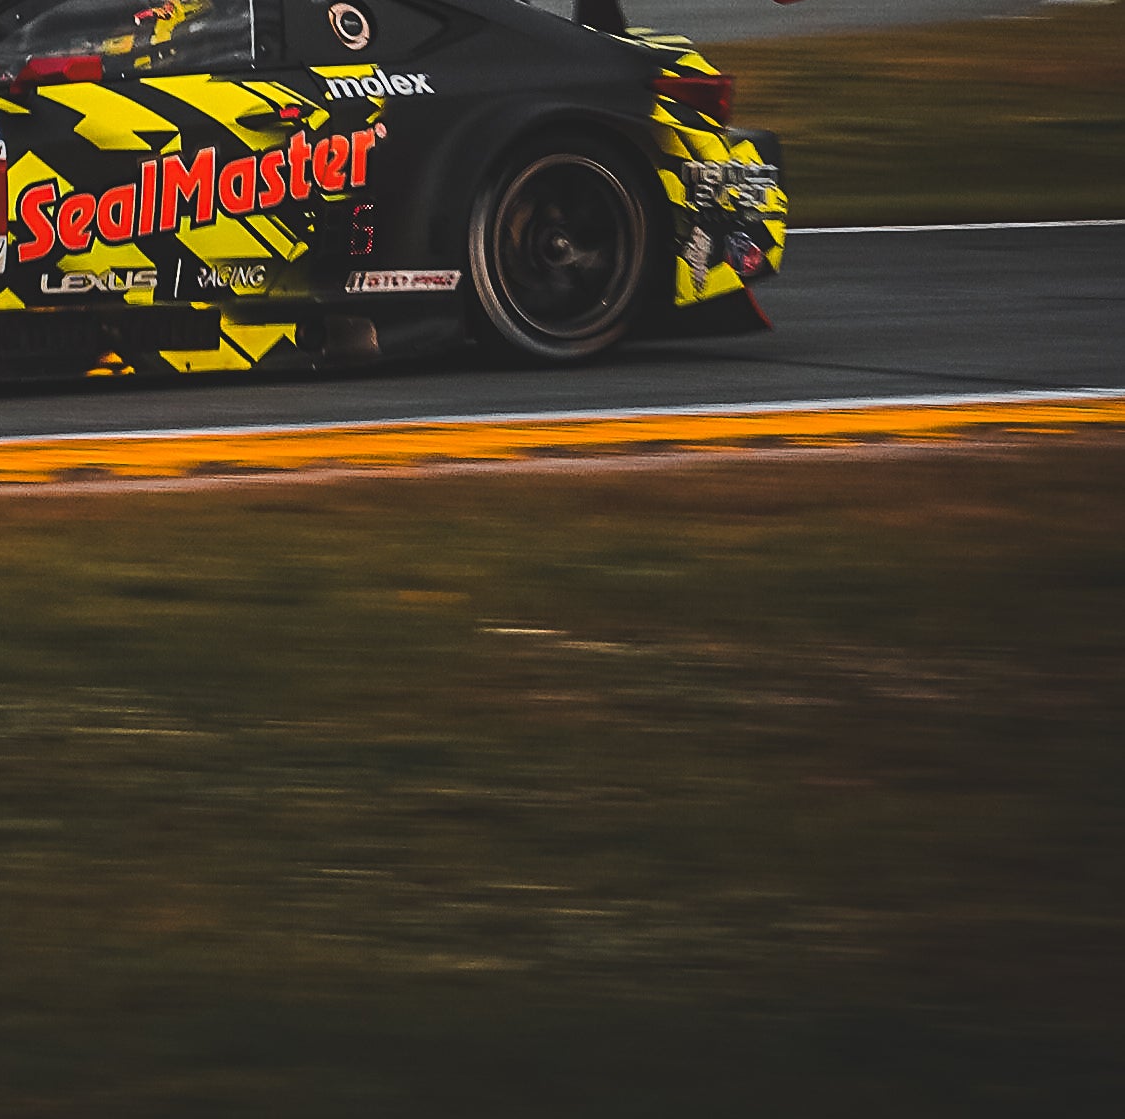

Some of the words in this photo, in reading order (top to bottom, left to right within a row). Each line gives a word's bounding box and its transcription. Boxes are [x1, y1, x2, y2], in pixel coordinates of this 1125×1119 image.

[326, 69, 435, 99] molex
[18, 126, 377, 263] SealMaster
[40, 269, 158, 295] LEXUS
[196, 264, 267, 289] RACING
